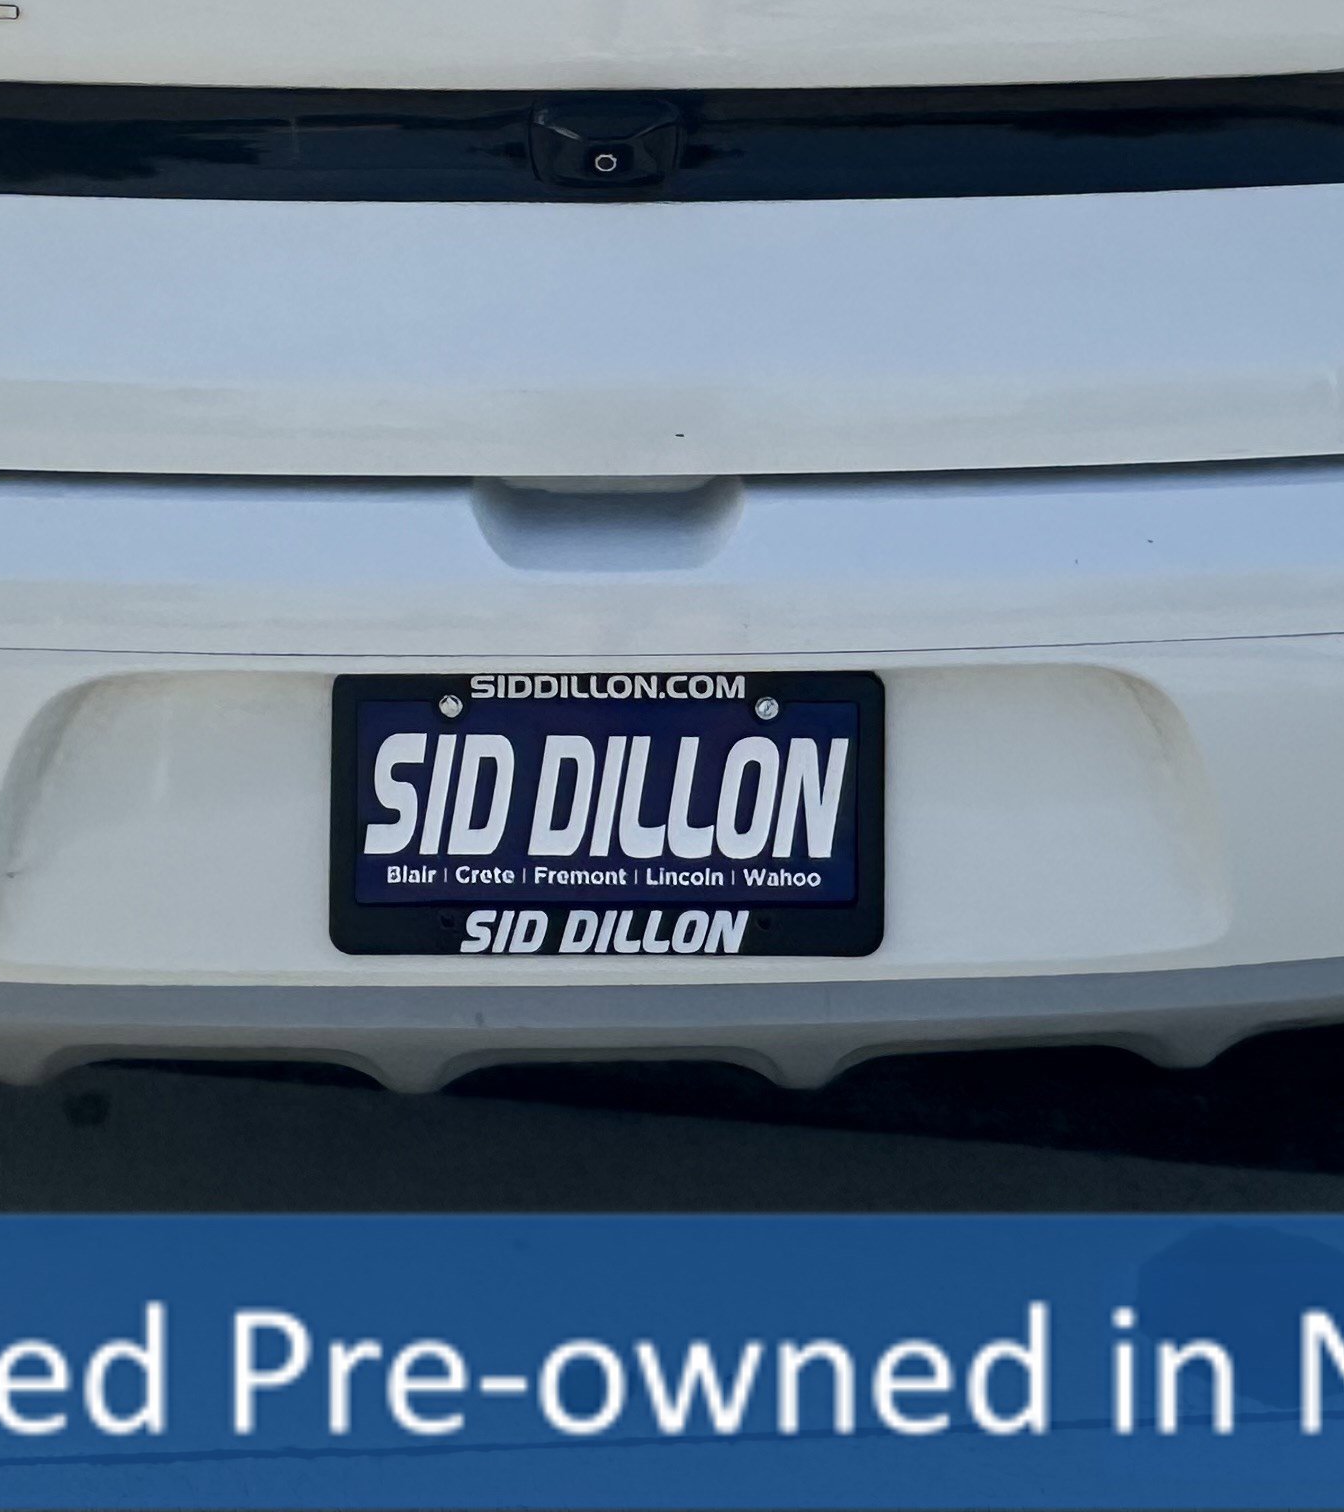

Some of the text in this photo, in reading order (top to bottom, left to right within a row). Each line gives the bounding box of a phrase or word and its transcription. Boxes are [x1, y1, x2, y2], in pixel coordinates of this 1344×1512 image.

[470, 674, 746, 700] SIDDILLON.COM
[363, 732, 849, 859] SID DILLON
[387, 865, 822, 888] Blair Crete Fremont Lincoln Wahoo
[460, 910, 750, 954] SID DILLON
